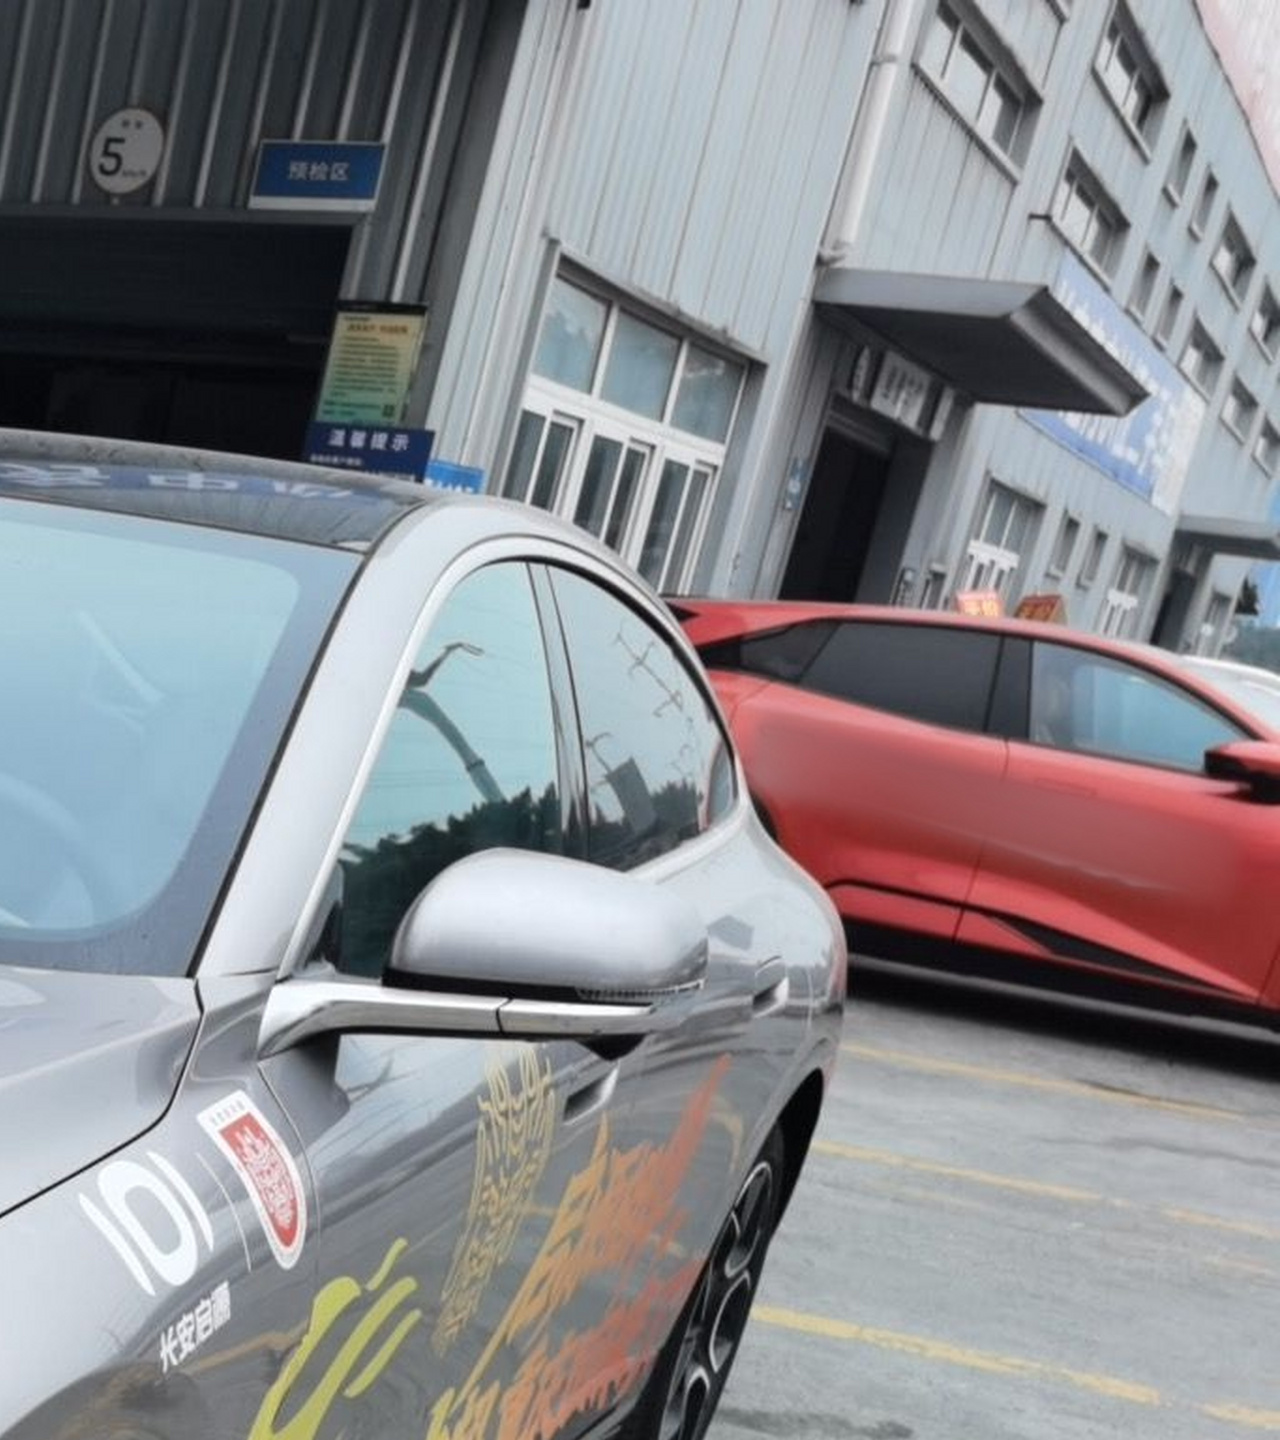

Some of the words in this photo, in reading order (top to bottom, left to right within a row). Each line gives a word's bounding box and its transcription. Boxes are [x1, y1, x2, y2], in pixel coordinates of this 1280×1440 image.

[98, 136, 126, 177] 5
[287, 160, 351, 181] 预检区
[327, 428, 411, 453] 温馨提示
[158, 1279, 232, 1374] 长安启源
